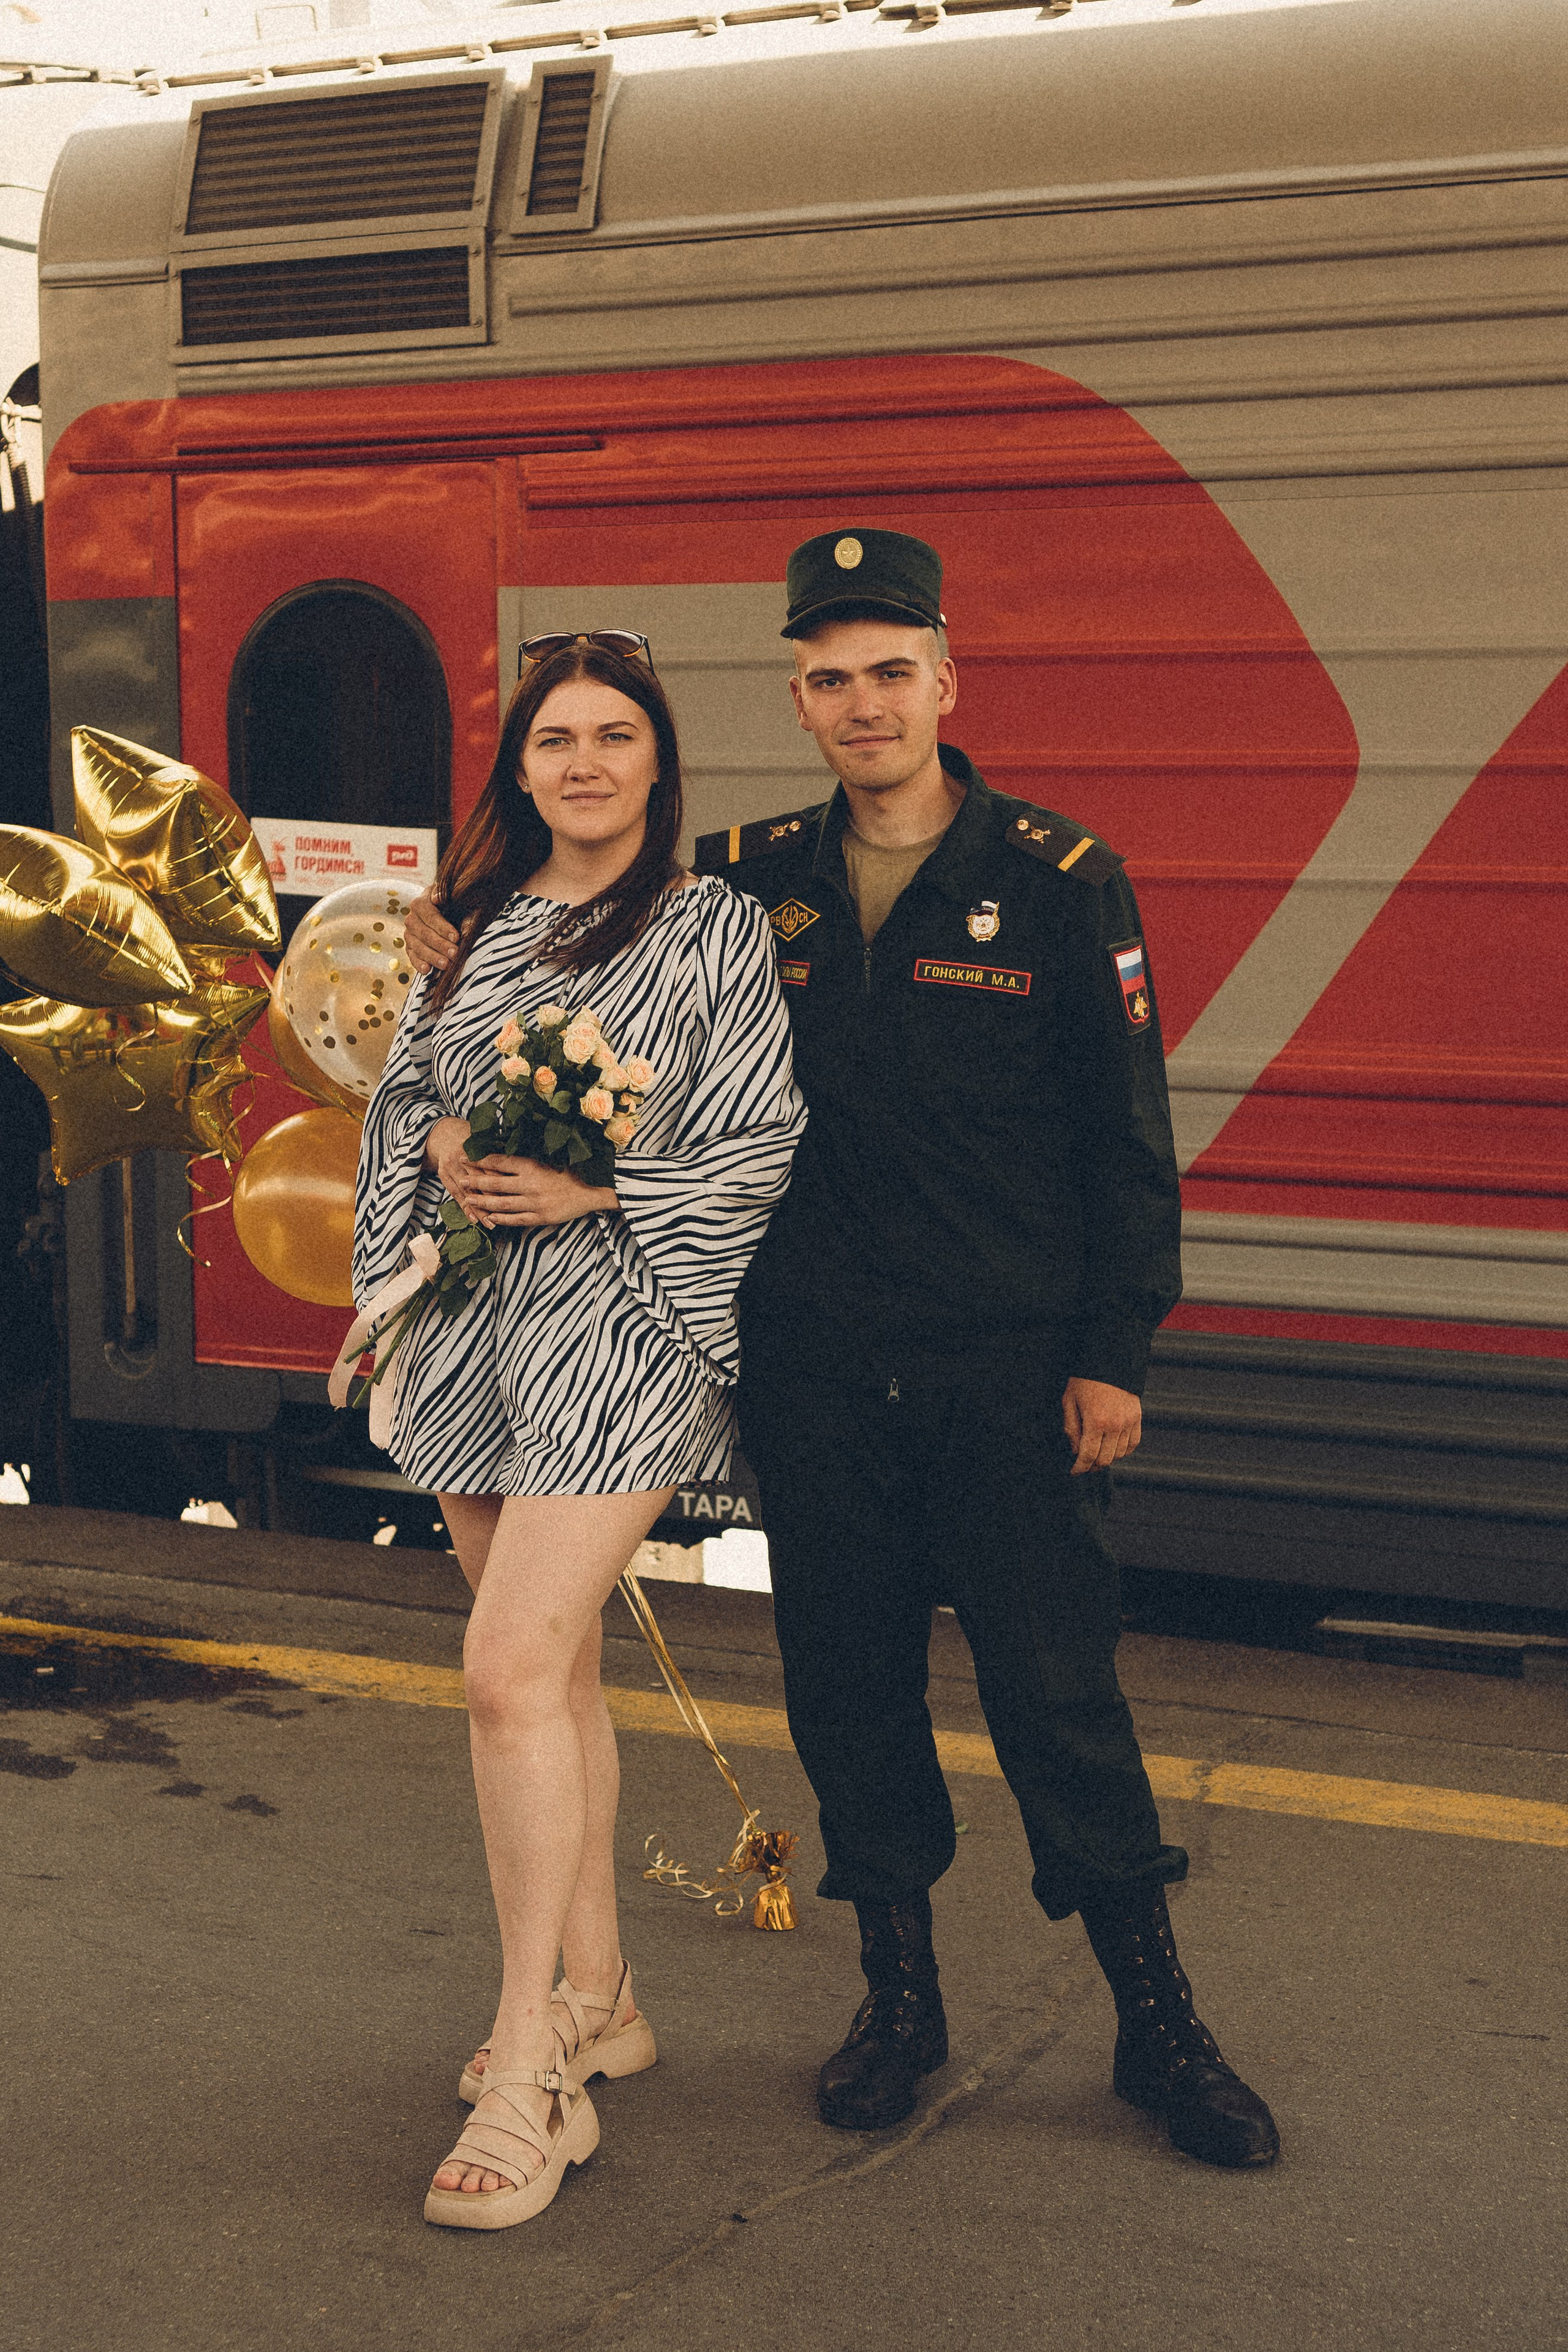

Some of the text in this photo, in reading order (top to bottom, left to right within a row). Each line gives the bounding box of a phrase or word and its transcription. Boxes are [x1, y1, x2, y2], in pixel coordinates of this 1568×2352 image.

[295, 836, 353, 857] ПОМНИМ,
[294, 856, 365, 875] ГОРДИМСЯ!
[799, 911, 808, 924] СН
[791, 967, 807, 979] РОССИИ
[924, 965, 1020, 989] ГОНСКИЙ М.А.
[678, 1491, 753, 1523] ТАРА
